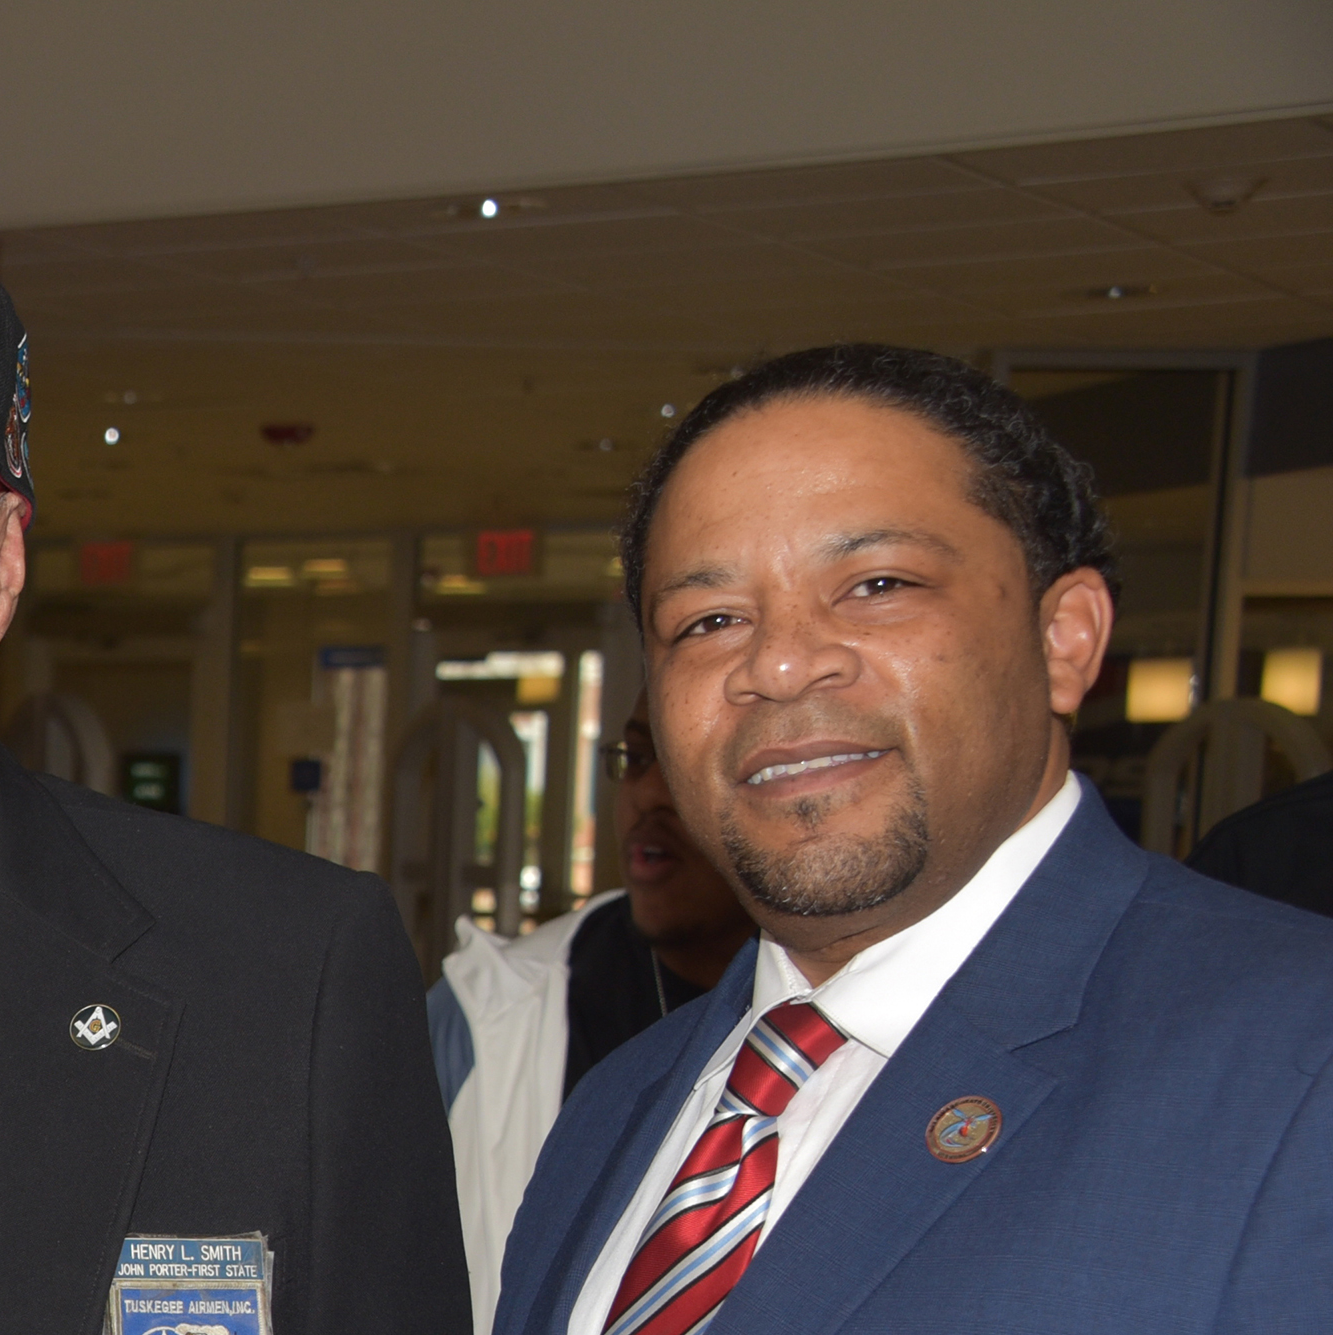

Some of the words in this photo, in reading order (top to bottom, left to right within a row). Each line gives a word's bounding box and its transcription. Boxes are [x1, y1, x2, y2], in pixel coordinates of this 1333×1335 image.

[130, 1243, 175, 1261] HENRY
[180, 1244, 195, 1261] L.
[200, 1245, 242, 1261] SMITH
[117, 1263, 145, 1277] JOHN
[148, 1263, 221, 1277] PORTER-FIRST
[225, 1264, 258, 1278] STATE
[124, 1299, 184, 1314] TUSKEGEE
